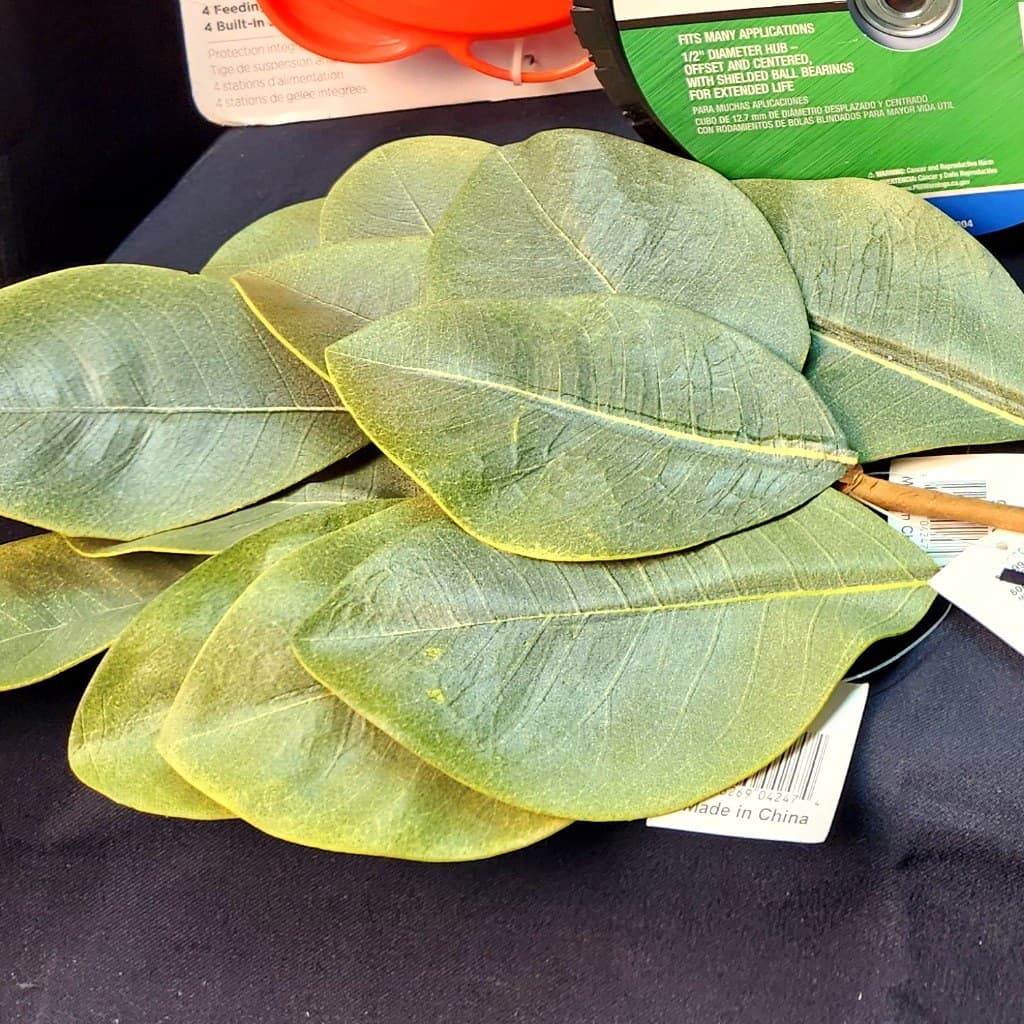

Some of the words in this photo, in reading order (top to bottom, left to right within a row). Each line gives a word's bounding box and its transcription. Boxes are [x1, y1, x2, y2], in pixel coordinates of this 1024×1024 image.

[202, 5, 210, 15] 4
[214, 1, 264, 15] Feedin
[204, 22, 212, 32] 4
[217, 18, 265, 32] Built-in
[678, 33, 702, 46] FITS
[704, 29, 736, 43] MANY
[739, 23, 815, 40] APPLICATIONS
[681, 50, 704, 62] 1/2"
[708, 45, 762, 60] DIAMETER
[765, 42, 788, 54] HUB
[684, 62, 725, 75] OFFSET
[727, 59, 750, 71] AND
[753, 54, 813, 69] CENTERED,
[223, 79, 266, 91] stations
[686, 75, 715, 88] WITH
[717, 71, 769, 85] SHIELDED
[771, 68, 799, 80] BALL
[801, 62, 855, 77] BEARINGS
[689, 88, 712, 101] FOR
[714, 83, 769, 99] EXTENDED
[772, 81, 795, 93] LIFE
[225, 95, 267, 108] stations
[692, 105, 715, 114] PARA
[716, 101, 751, 113] MUCHAS
[752, 96, 809, 109] APLICACIONES
[695, 116, 717, 126] CUBO
[719, 115, 730, 124] DE
[734, 114, 749, 122] 12.7
[768, 110, 779, 119] DE
[825, 101, 876, 114] DESPLAZADO
[885, 94, 928, 107] CENTRADO
[697, 125, 714, 134] CON
[716, 120, 773, 133] RODAMIENTOS
[775, 119, 786, 128] DE
[788, 116, 814, 127] BOLAS
[816, 111, 861, 124] BLINDADOS
[863, 109, 885, 119] PARA
[886, 105, 916, 116] MAYOR
[917, 102, 936, 112] VIDA
[736, 804, 752, 820] in
[758, 807, 809, 825] China
